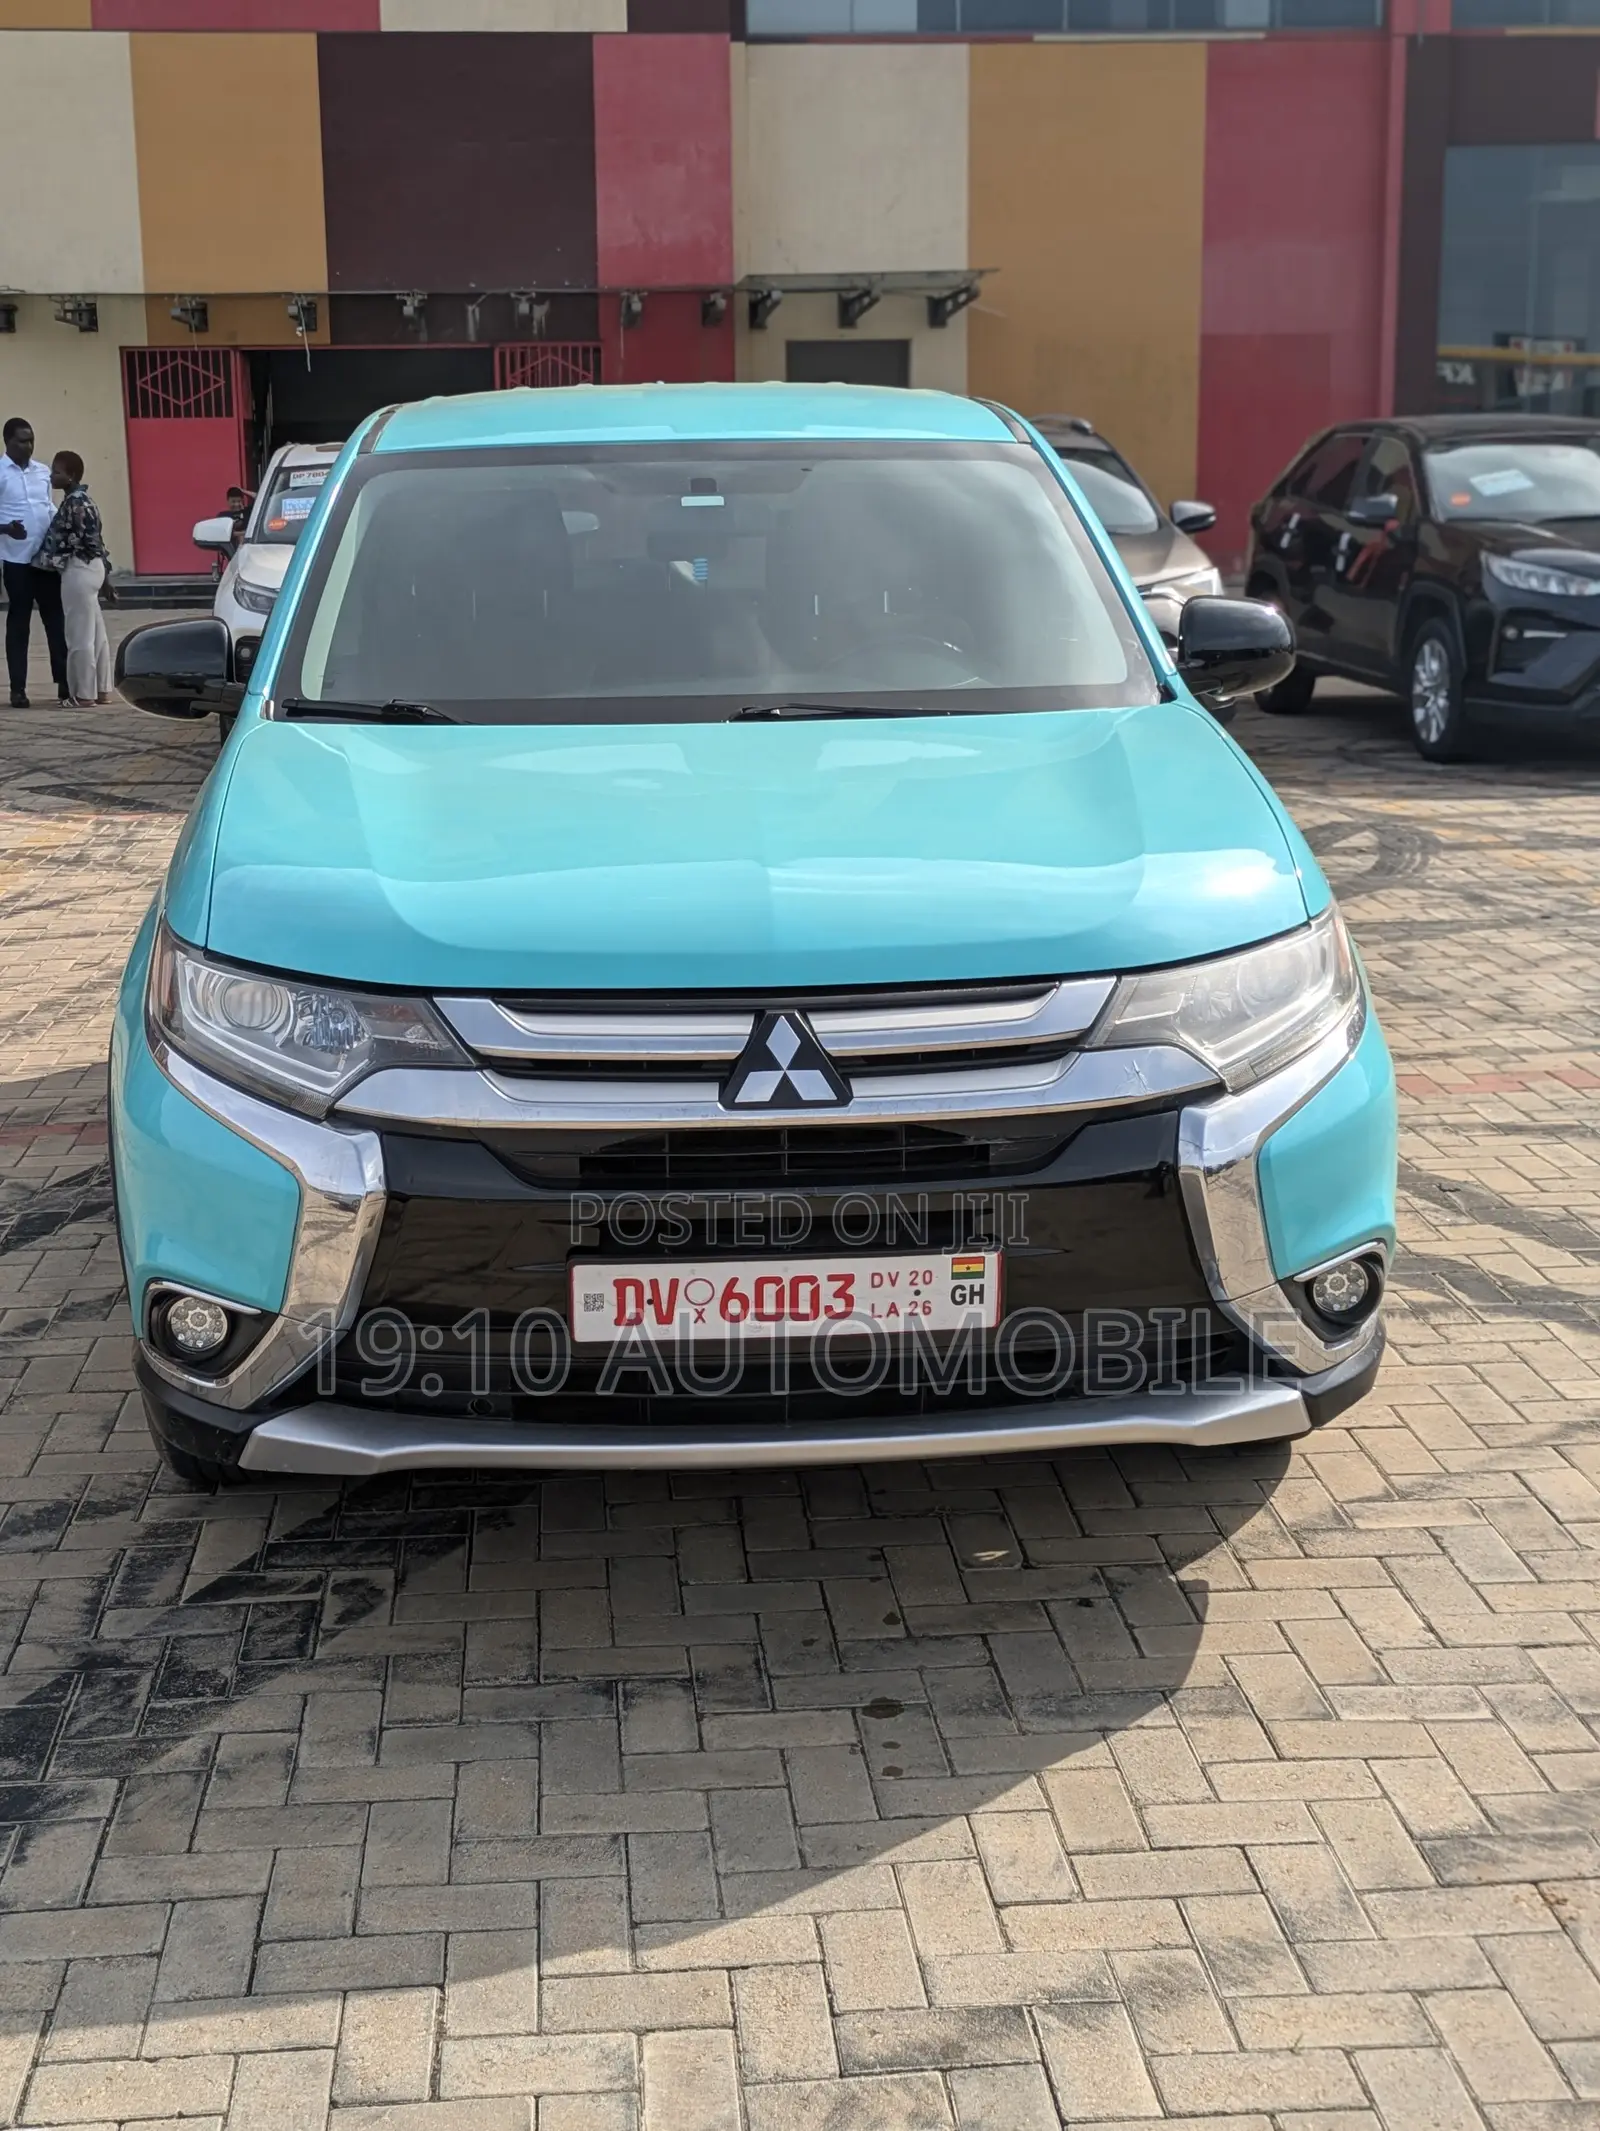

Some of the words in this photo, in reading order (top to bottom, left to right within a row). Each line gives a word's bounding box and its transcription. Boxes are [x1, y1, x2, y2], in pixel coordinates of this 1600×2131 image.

[871, 1271, 899, 1289] DV
[909, 1269, 933, 1286] 20
[613, 1277, 679, 1327] DV
[719, 1274, 855, 1323] 6003
[951, 1284, 985, 1306] GH
[871, 1301, 900, 1319] LA
[908, 1300, 932, 1317] 26
